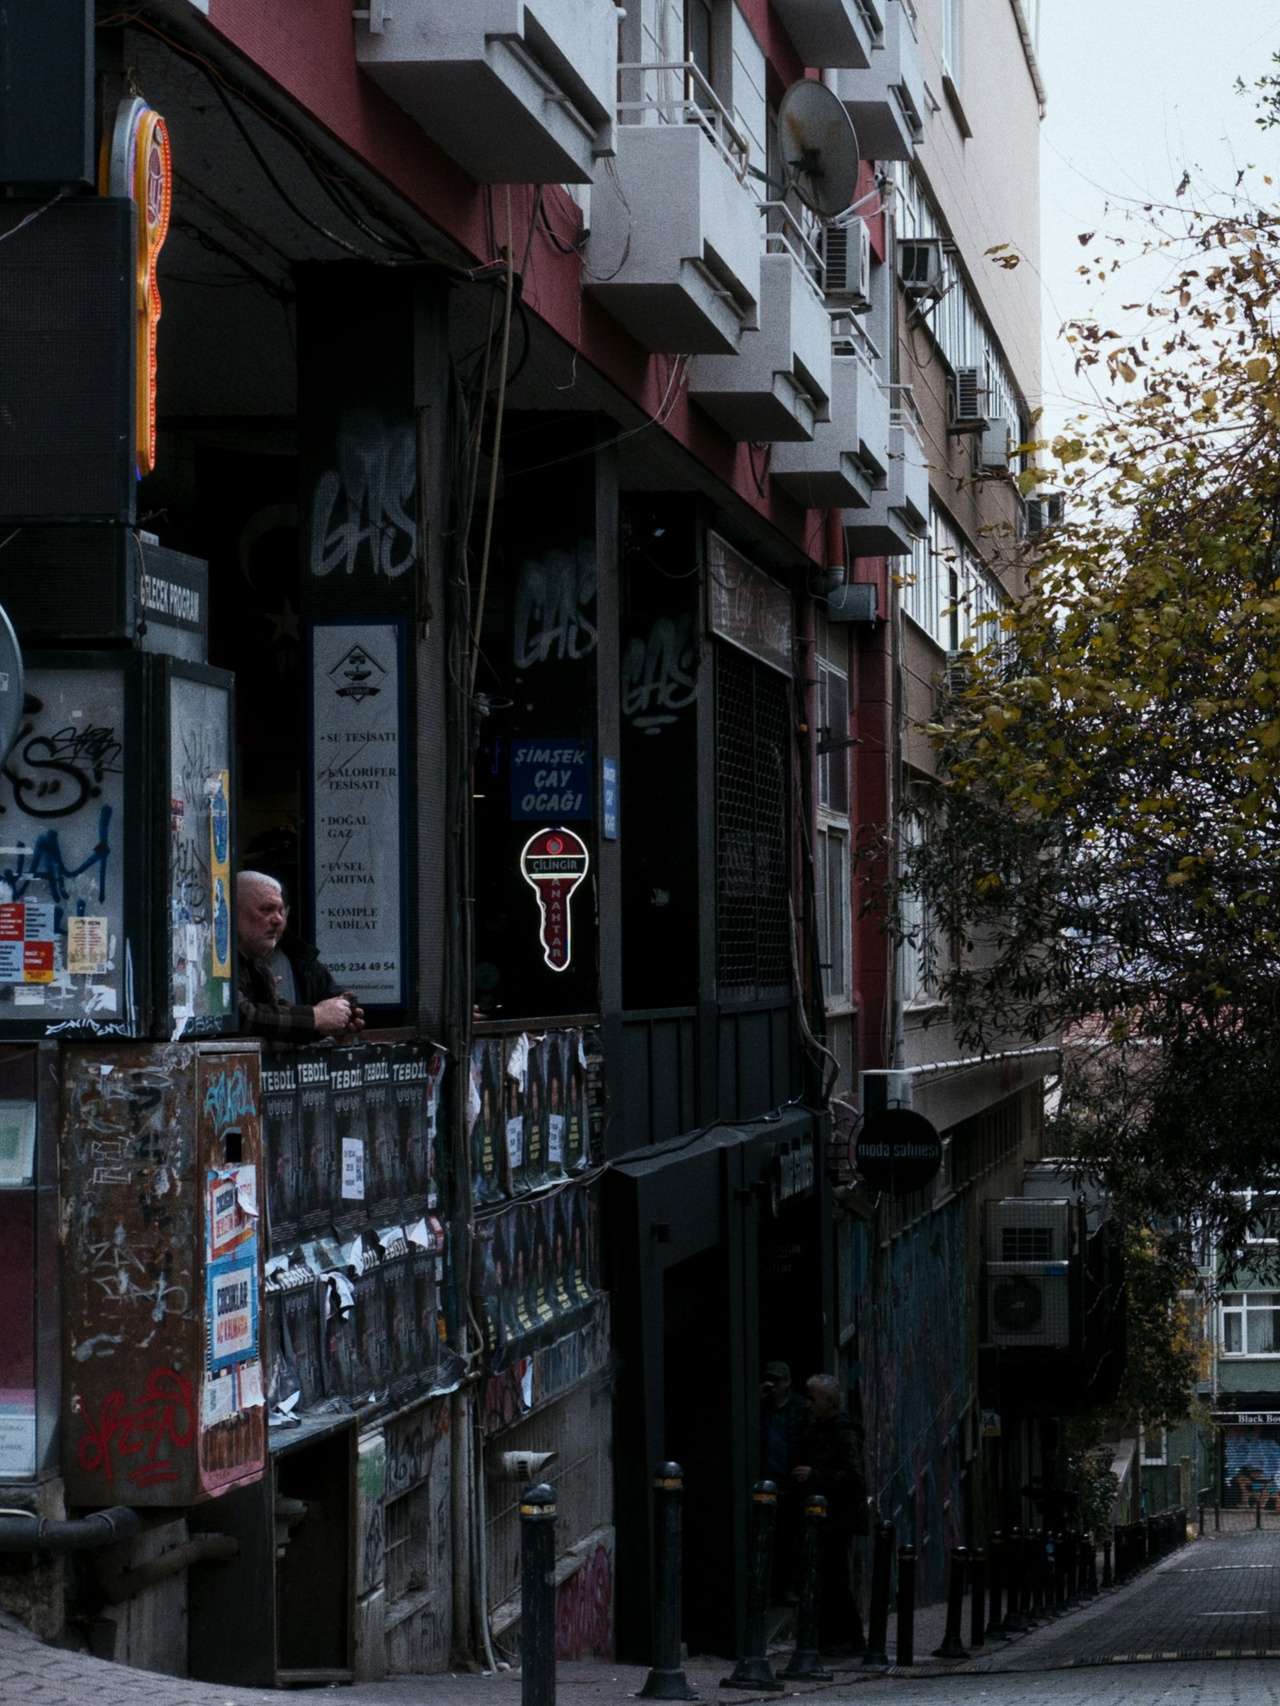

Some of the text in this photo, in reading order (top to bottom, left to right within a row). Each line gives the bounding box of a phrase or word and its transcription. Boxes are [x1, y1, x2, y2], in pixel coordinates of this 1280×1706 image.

[140, 574, 168, 613] GELECEK
[327, 730, 396, 742] SU TESİSATI
[514, 745, 585, 767] ŞİMŞEK
[328, 765, 396, 778] KALORİFER
[329, 778, 380, 790] TESİSATI
[533, 769, 572, 791] ÇAY
[520, 790, 583, 812] OCAĞI
[328, 814, 369, 826] DOĞAL
[328, 829, 353, 838] GAZ
[328, 862, 365, 872] EVSEL
[532, 857, 579, 872] ÇİLİNGİR
[328, 875, 375, 884] ARITMA
[328, 908, 378, 917] KOMPLE
[551, 878, 561, 957] ANAHTAR
[328, 919, 377, 930] TADİLAT
[349, 962, 366, 971] 234
[369, 962, 381, 971] 49
[384, 962, 395, 970] 54
[298, 1057, 329, 1083] TEBDİL
[331, 1063, 363, 1090] TEBDİL
[364, 1057, 390, 1082] TEBDİL
[392, 1057, 427, 1081] TEBDİL
[261, 1065, 297, 1091] TEBDİL
[858, 1140, 939, 1157] moda sahnesi
[1238, 1414, 1263, 1423] Black
